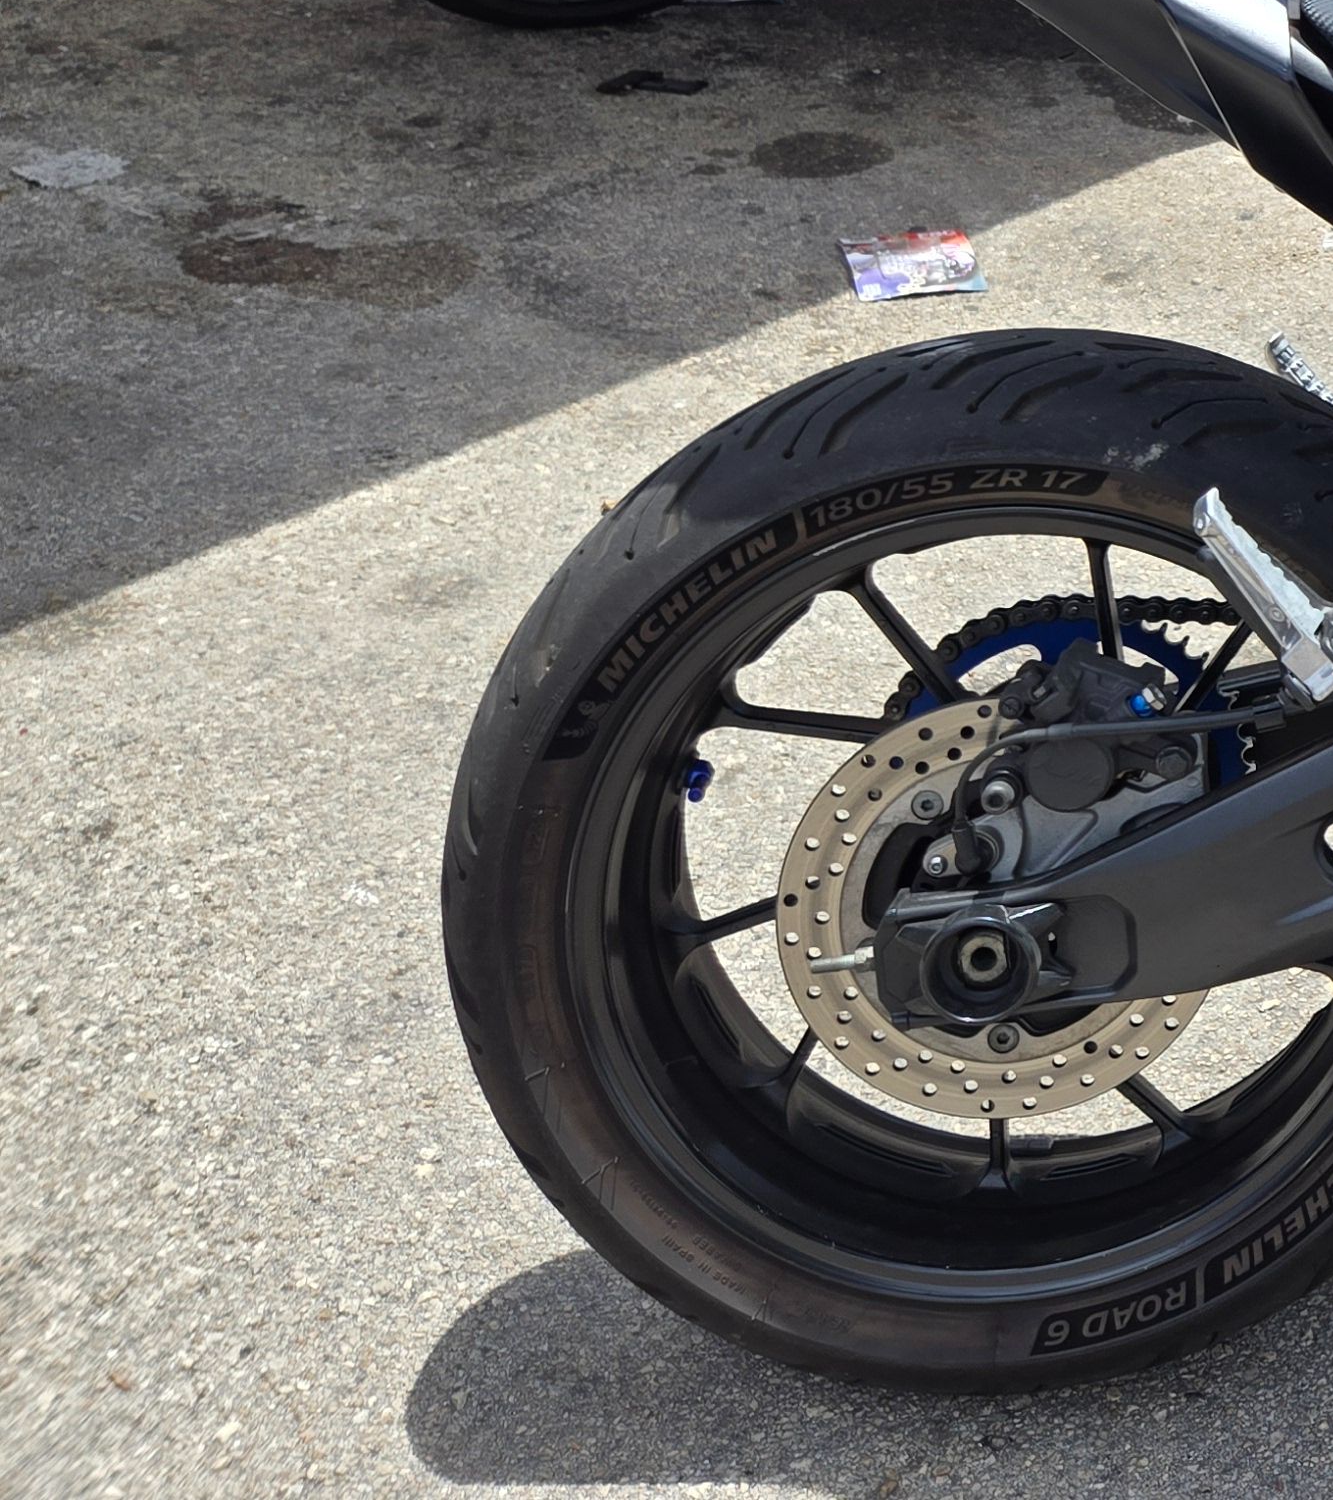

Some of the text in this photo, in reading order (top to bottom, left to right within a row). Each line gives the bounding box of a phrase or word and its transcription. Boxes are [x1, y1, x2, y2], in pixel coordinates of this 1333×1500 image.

[597, 468, 1088, 693] MICHELIN 180/55 ZR 17
[1044, 1318, 1071, 1347] 6
[1081, 1280, 1188, 1338] ROAD
